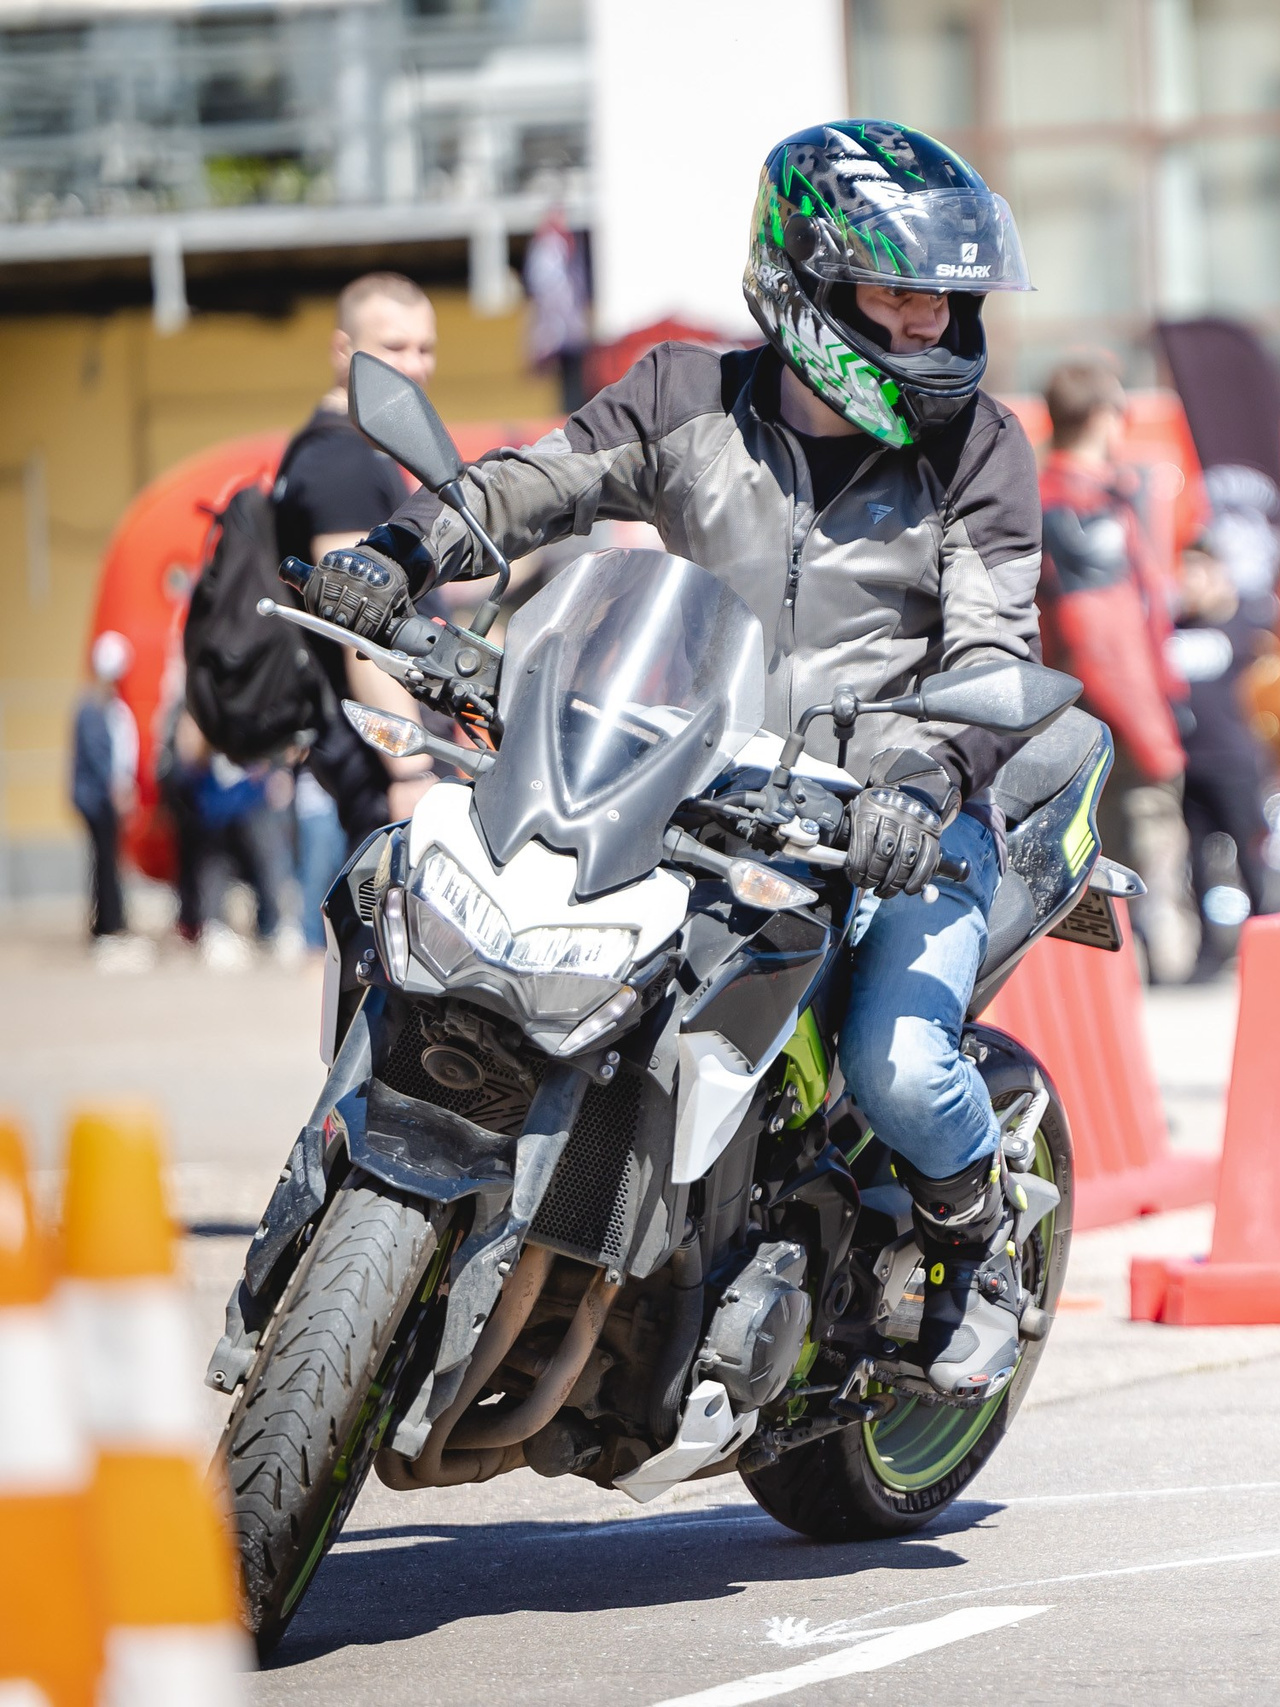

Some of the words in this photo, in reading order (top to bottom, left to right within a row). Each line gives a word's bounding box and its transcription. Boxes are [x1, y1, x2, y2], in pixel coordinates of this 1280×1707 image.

[936, 263, 991, 278] SHARK
[481, 1237, 518, 1265] ABS
[896, 1457, 973, 1511] MICHELIN
